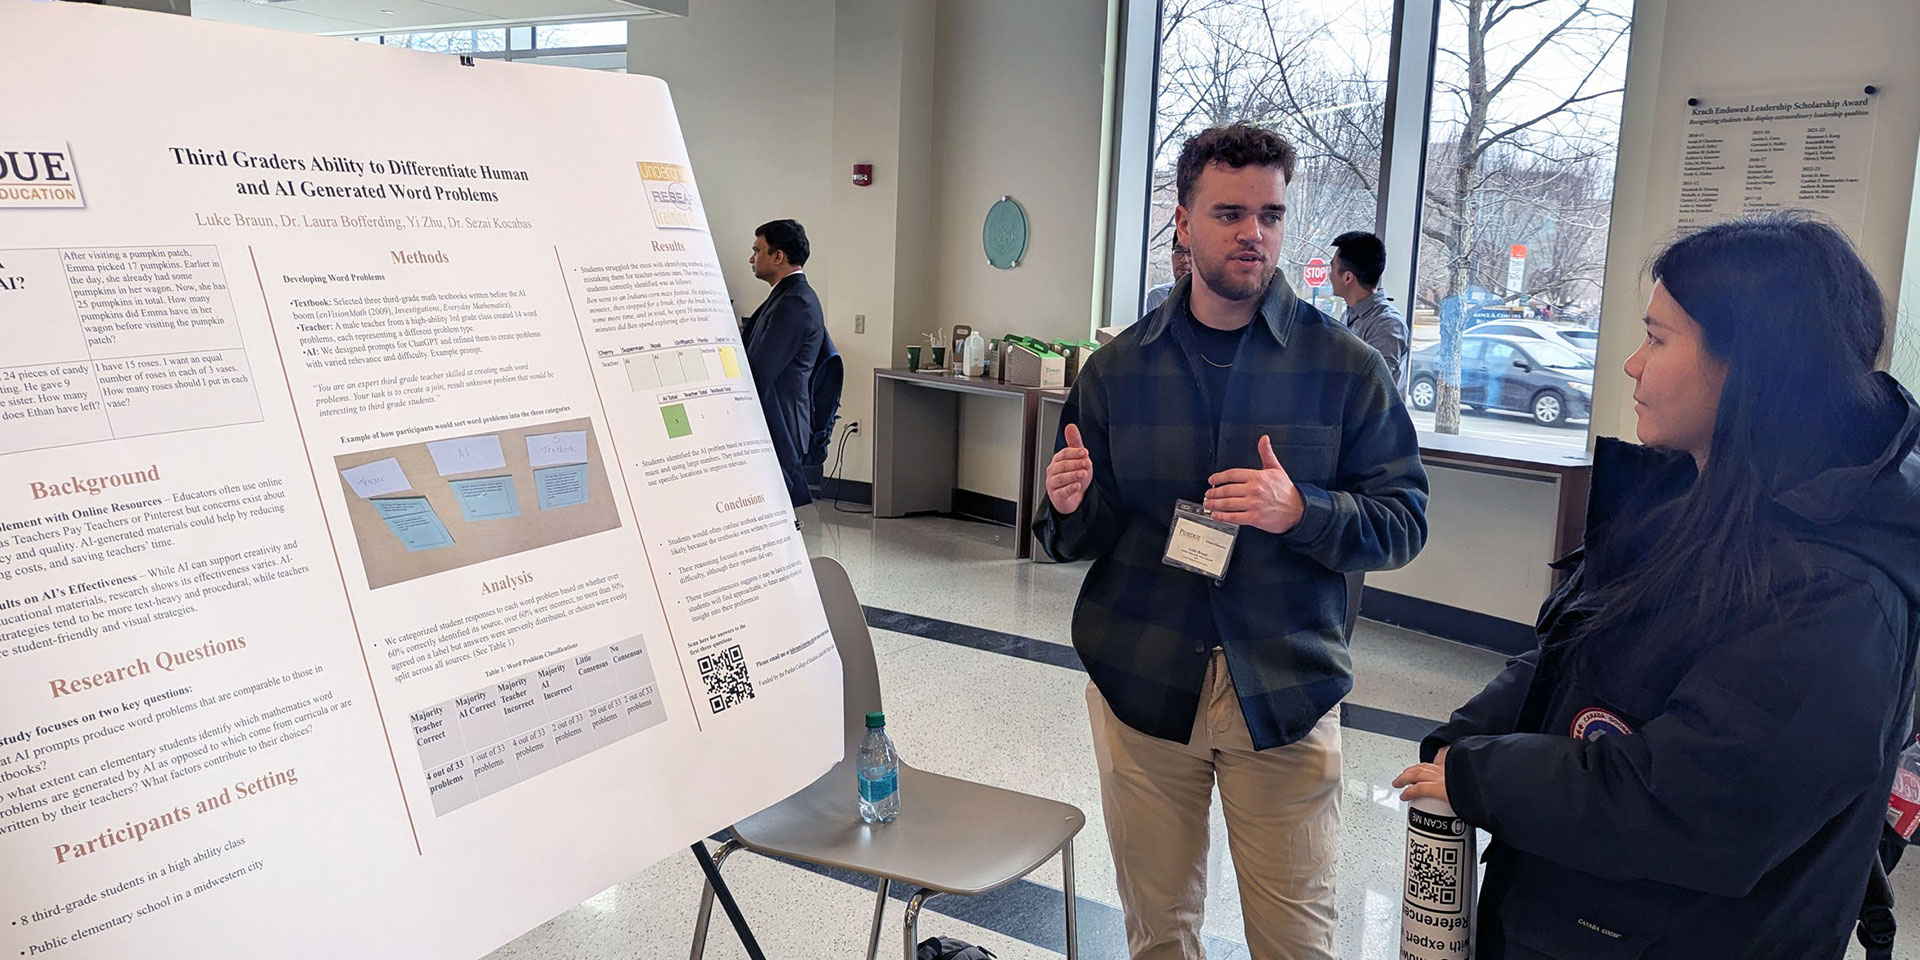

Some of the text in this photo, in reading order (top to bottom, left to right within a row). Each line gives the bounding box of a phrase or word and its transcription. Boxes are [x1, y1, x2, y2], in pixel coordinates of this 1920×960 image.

[1692, 97, 1868, 115] Krach Endowed Leadership Scholarship Award
[169, 147, 528, 180] Third Graders Ability to Differentiate Human
[236, 179, 498, 201] and AI Generated Word Problems
[195, 212, 532, 230] Luke Braun, Dr. Laura Bofferding, Yi Zhu, Dr. Sezai Kocabas
[63, 251, 86, 260] After
[87, 250, 121, 260] visiting
[128, 249, 166, 260] pumpkin
[167, 248, 192, 258] patch,
[651, 240, 686, 252] Results
[392, 250, 449, 264] Methods
[66, 259, 219, 273] Emma picked 17 pumpkins. Earlier in
[580, 265, 604, 274] Students
[604, 263, 630, 273] struggled
[1306, 267, 1325, 278] STOP
[69, 275, 84, 284] the
[85, 275, 104, 285] day,
[105, 274, 120, 283] she
[122, 273, 152, 283] already
[153, 272, 170, 280] had
[282, 274, 327, 284] Developing
[350, 273, 384, 281] Problems
[88, 335, 116, 347] patch?
[300, 334, 336, 346] problems,
[336, 332, 354, 341] each
[354, 329, 397, 342] representing
[403, 327, 432, 336] different
[433, 325, 459, 336] problem
[95, 363, 99, 371] I
[101, 362, 122, 371] have
[125, 360, 135, 369] 15
[137, 360, 162, 368] roses.
[201, 352, 222, 364] equal
[30, 464, 160, 499] Background
[44, 512, 69, 523] with
[71, 506, 108, 518] Online
[110, 498, 162, 512] Resources
[172, 490, 216, 502] Educators
[218, 485, 240, 494] often
[258, 478, 281, 488] online
[715, 494, 765, 513] Conclusions
[667, 535, 691, 546] Students
[691, 528, 708, 538] would
[481, 571, 533, 595] Analysis
[610, 644, 619, 653] No
[612, 649, 642, 663] Consensus
[49, 636, 246, 698] Research Questions
[575, 654, 592, 666] Little
[538, 664, 566, 679] Majority
[578, 661, 609, 676] Consensus
[497, 677, 527, 692] Majority
[541, 680, 550, 690] AI
[544, 684, 572, 700] Incorrect
[456, 692, 486, 707] Majority
[500, 689, 527, 703] Teacher
[35, 718, 78, 736] focuses
[81, 713, 96, 722] on
[98, 707, 119, 717] two
[121, 700, 139, 711] key
[143, 686, 192, 706] questions:
[411, 707, 443, 722] Majority
[459, 700, 496, 719] AI Correct
[503, 698, 534, 715] Incorrect
[413, 720, 442, 735] Teacher
[417, 731, 446, 746] Correct
[426, 760, 464, 780] 4 out of 33
[430, 775, 464, 794] problems
[53, 768, 298, 864] Participants and Setting
[1412, 812, 1447, 829] SCAN ME
[20, 837, 245, 925] 8 third-grade students in a high ability class
[28, 936, 68, 956] Public
[70, 912, 132, 941] elementary
[136, 896, 170, 917] school
[172, 893, 183, 902] in
[193, 868, 246, 894] midwestern
[247, 860, 262, 871] city
[1406, 930, 1445, 950] expert
